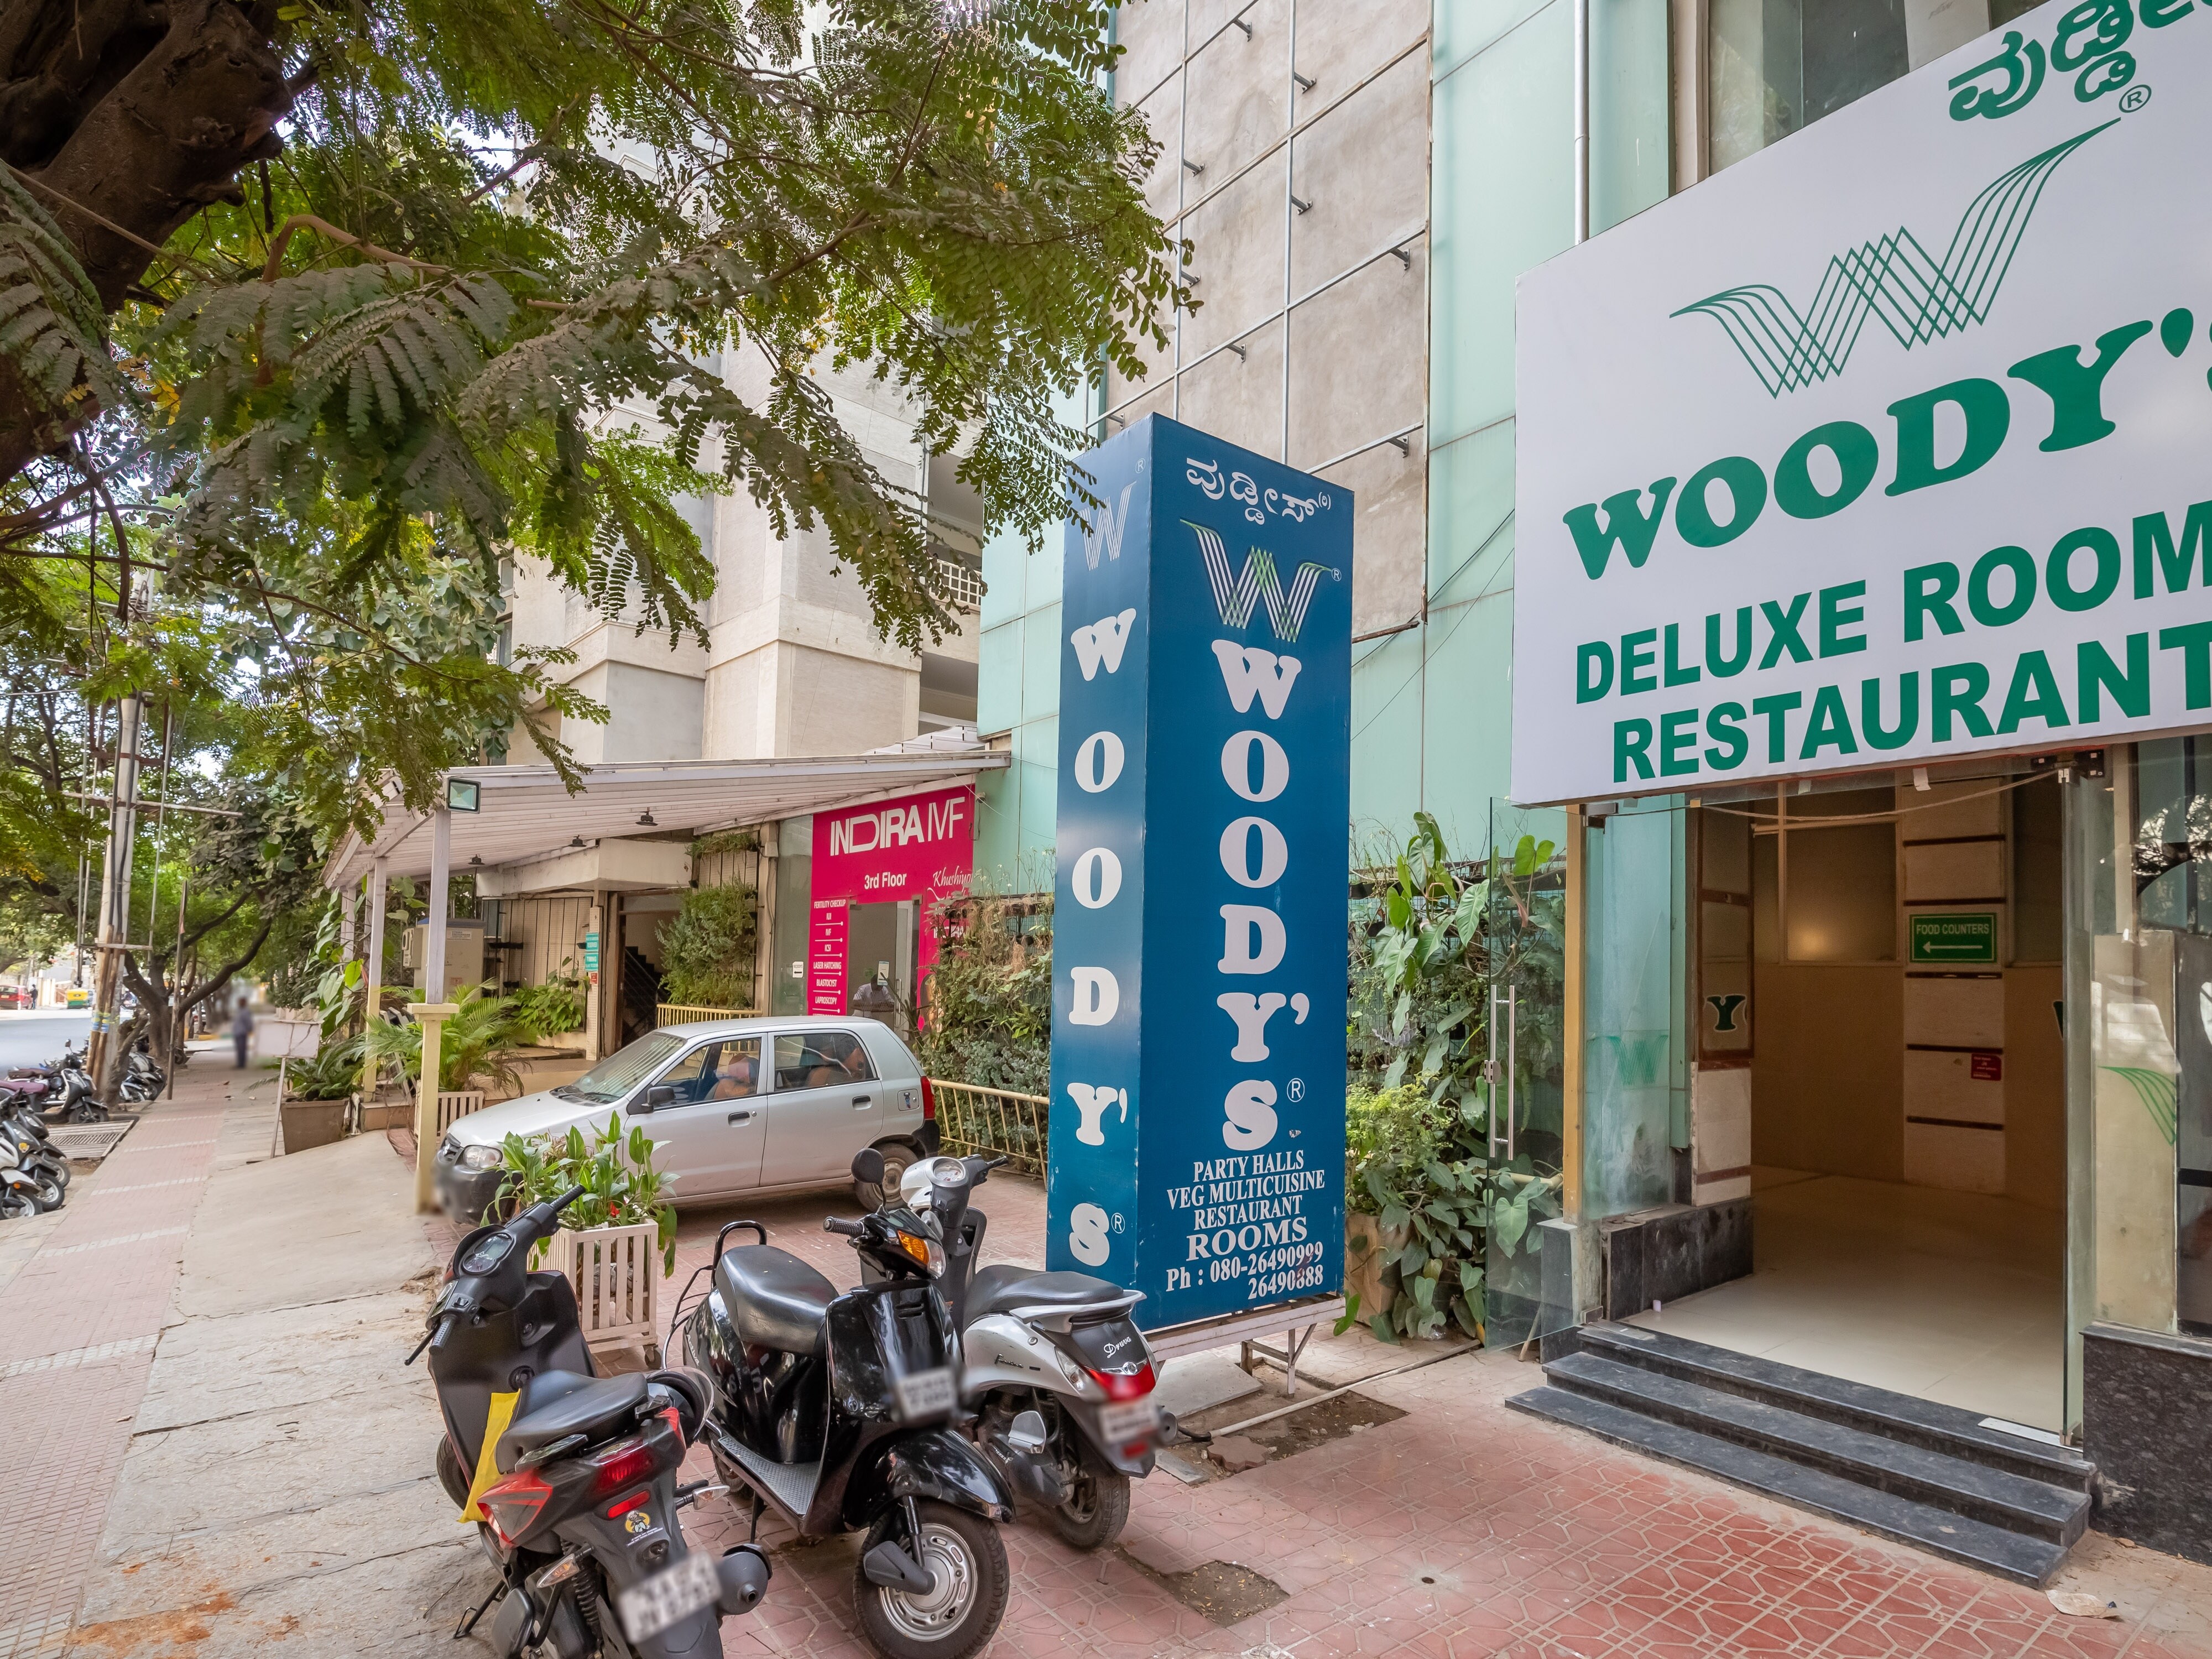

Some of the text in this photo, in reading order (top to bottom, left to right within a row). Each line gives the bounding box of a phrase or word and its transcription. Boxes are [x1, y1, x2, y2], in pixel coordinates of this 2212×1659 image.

[1562, 307, 2212, 580] WOODY'
[1576, 579, 1867, 704] DELUXE
[1613, 620, 2212, 782] RESTAURANT
[830, 805, 925, 856] INDIRA
[864, 872, 907, 890] 3rd Floor
[814, 899, 846, 909] FERTILITY CHECKUP
[1916, 924, 1990, 935] FOOD COUNTERS
[816, 979, 837, 987] BLASTOCYST
[824, 962, 842, 970] HATCHING
[815, 996, 837, 1005] LAPROSCOPY
[1193, 1150, 1304, 1182] PARTY HALLS
[1166, 1170, 1326, 1210] VEG MULTICUISINE
[1193, 1194, 1303, 1230] RESTAURANT
[1186, 1216, 1307, 1261] ROOMS
[1209, 1241, 1323, 1283] 080-26490999
[1248, 1264, 1323, 1300] 26490888
[1103, 1342, 1132, 1359] Druva
